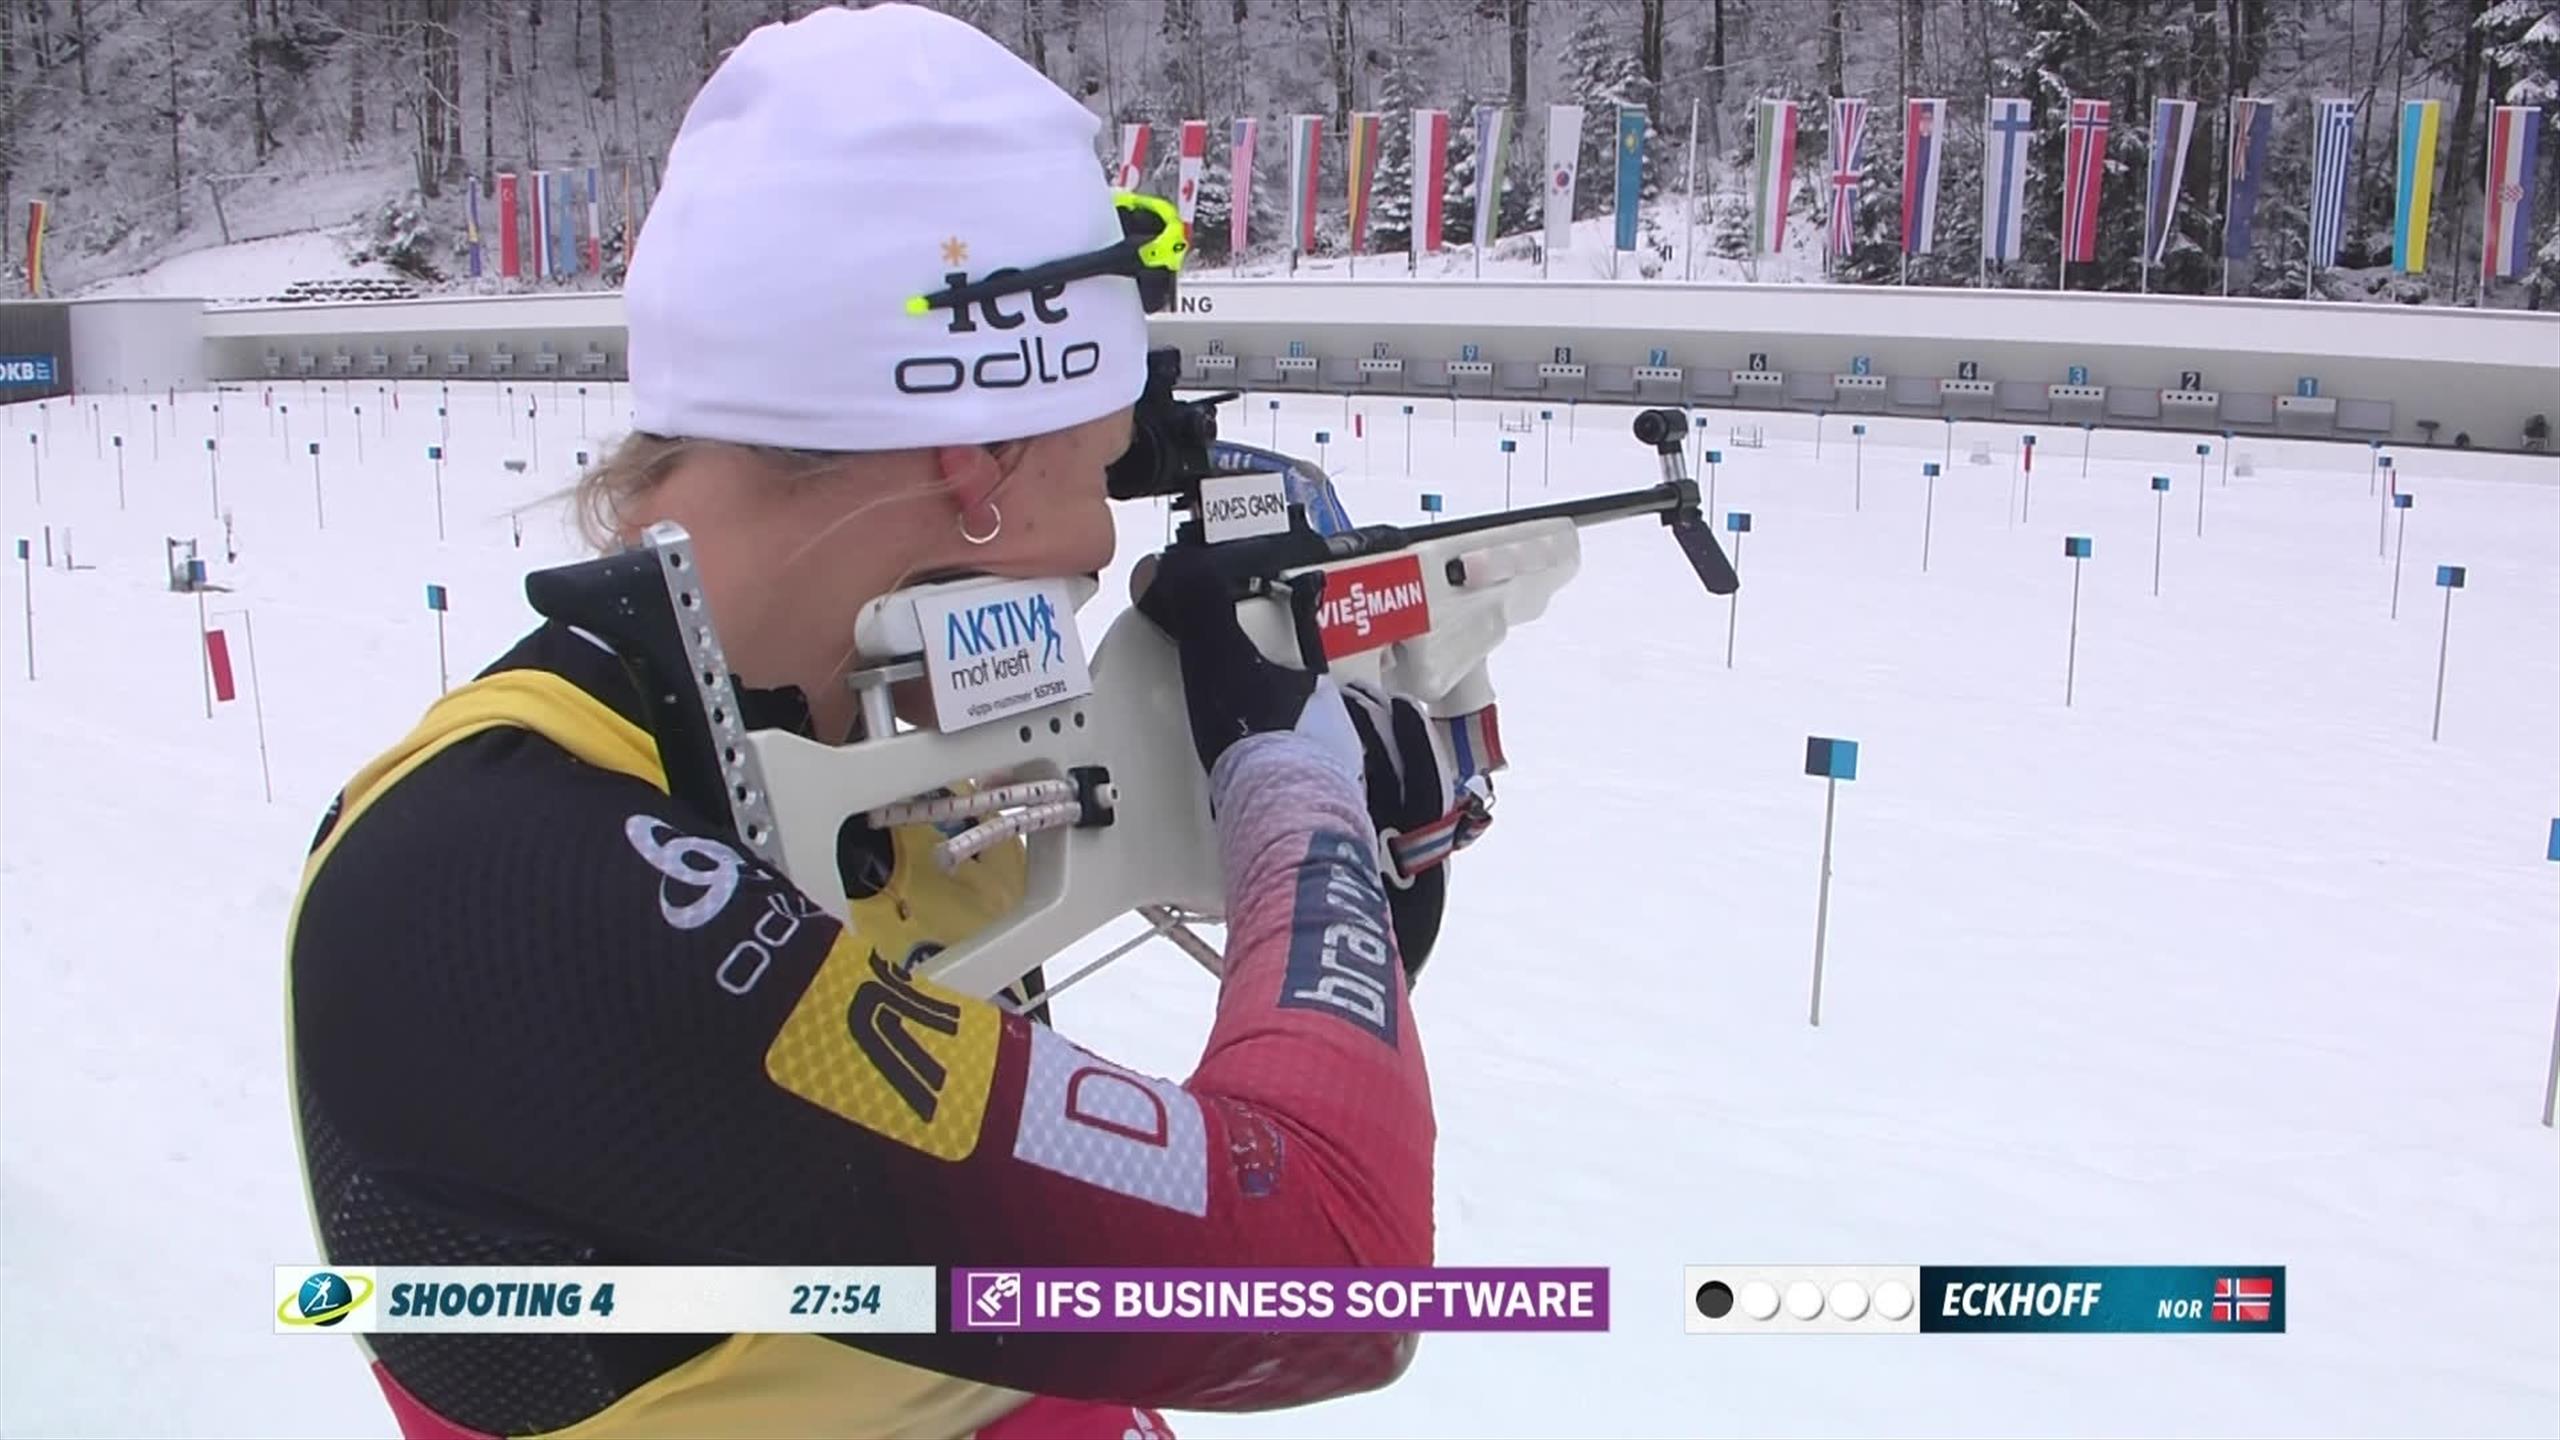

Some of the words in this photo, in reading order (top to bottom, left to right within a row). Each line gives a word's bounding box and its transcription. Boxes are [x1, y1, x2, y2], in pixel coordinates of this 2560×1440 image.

[1181, 296, 1212, 313] NG
[895, 336, 1100, 393] odlo
[1557, 349, 1569, 364] 8
[1653, 351, 1665, 366] 7
[1753, 355, 1764, 370] 6
[1855, 358, 1867, 374] 5
[1961, 363, 1975, 379] 4
[2072, 368, 2085, 384] 3
[2185, 373, 2198, 390] 2
[2302, 379, 2315, 396] 1
[1316, 582, 1423, 636] VIESSMANN
[947, 594, 1046, 661] AKTIV
[952, 656, 989, 690] mot
[992, 648, 1032, 682] kreft
